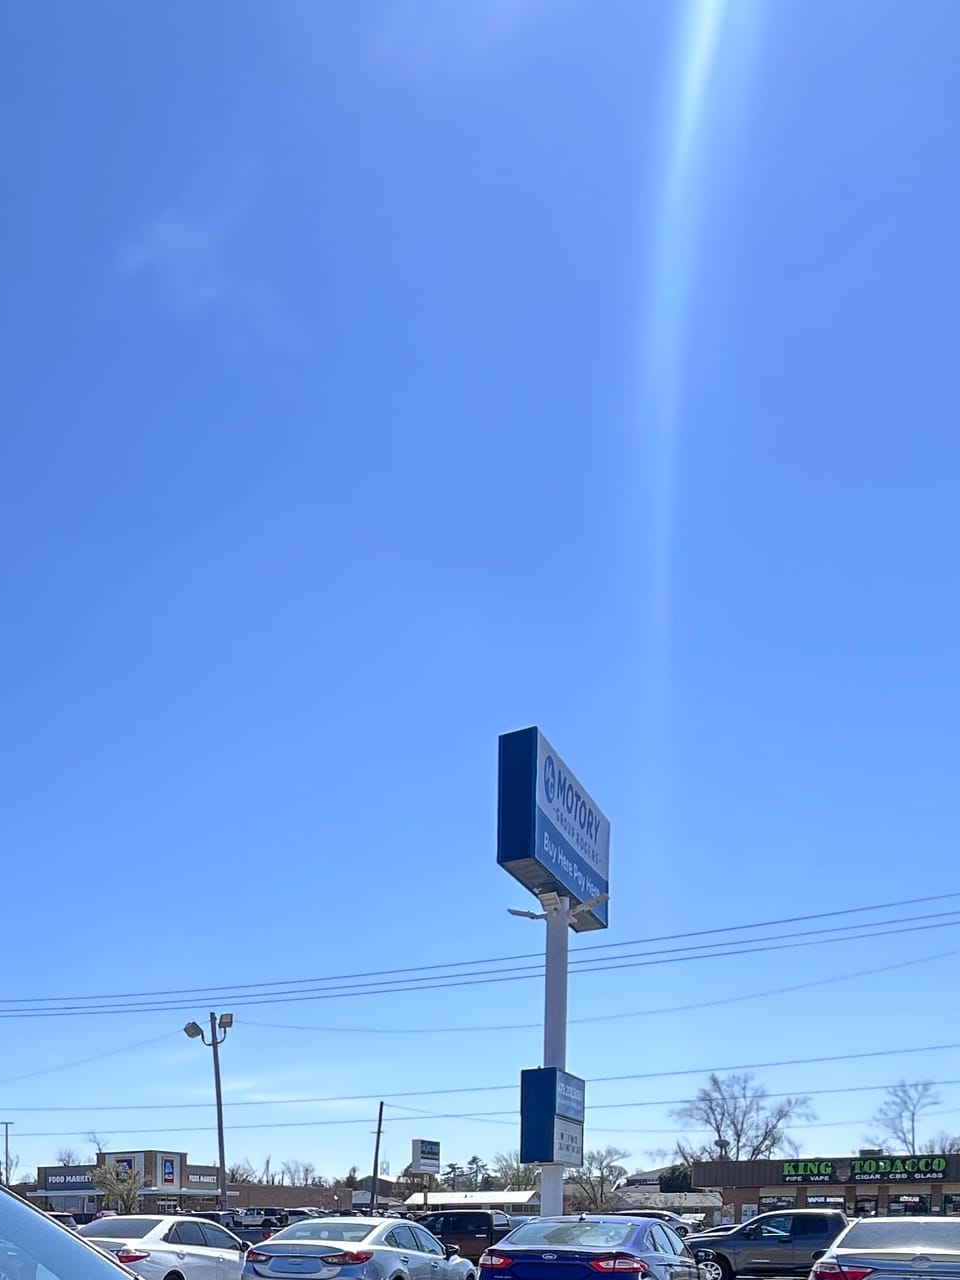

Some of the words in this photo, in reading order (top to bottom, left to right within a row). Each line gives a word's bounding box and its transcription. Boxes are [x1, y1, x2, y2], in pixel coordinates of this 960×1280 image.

[557, 769, 601, 845] MOTORY
[543, 831, 558, 864] Buy
[557, 846, 573, 877] Here
[573, 862, 586, 892] Pay
[48, 1176, 65, 1184] FOOD
[782, 1161, 833, 1176] KING
[851, 1158, 946, 1174] TOBACCO
